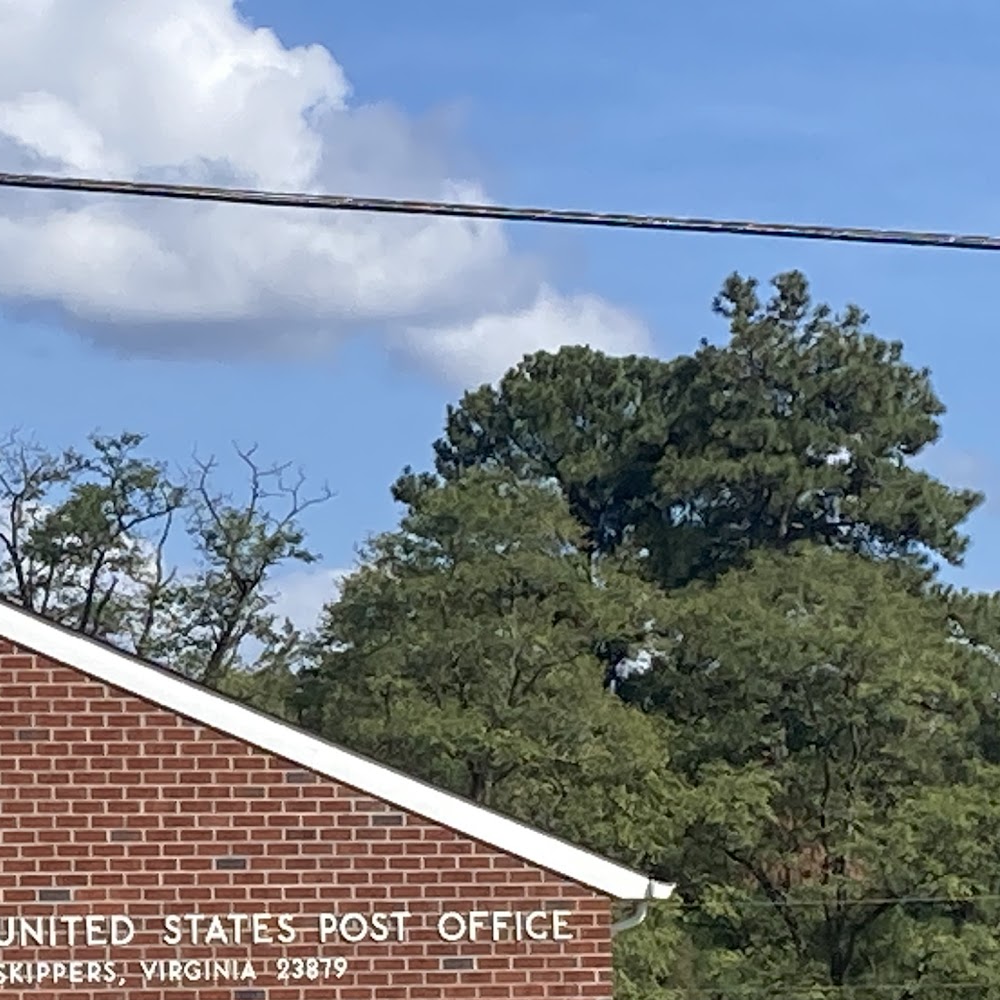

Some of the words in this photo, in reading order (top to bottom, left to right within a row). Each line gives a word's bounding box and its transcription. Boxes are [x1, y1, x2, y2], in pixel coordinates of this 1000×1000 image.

[163, 912, 296, 945] STATES
[319, 911, 411, 944] POST
[438, 909, 574, 942] OFFICE
[140, 957, 257, 983] VIRGINIA
[276, 956, 349, 981] 23879
